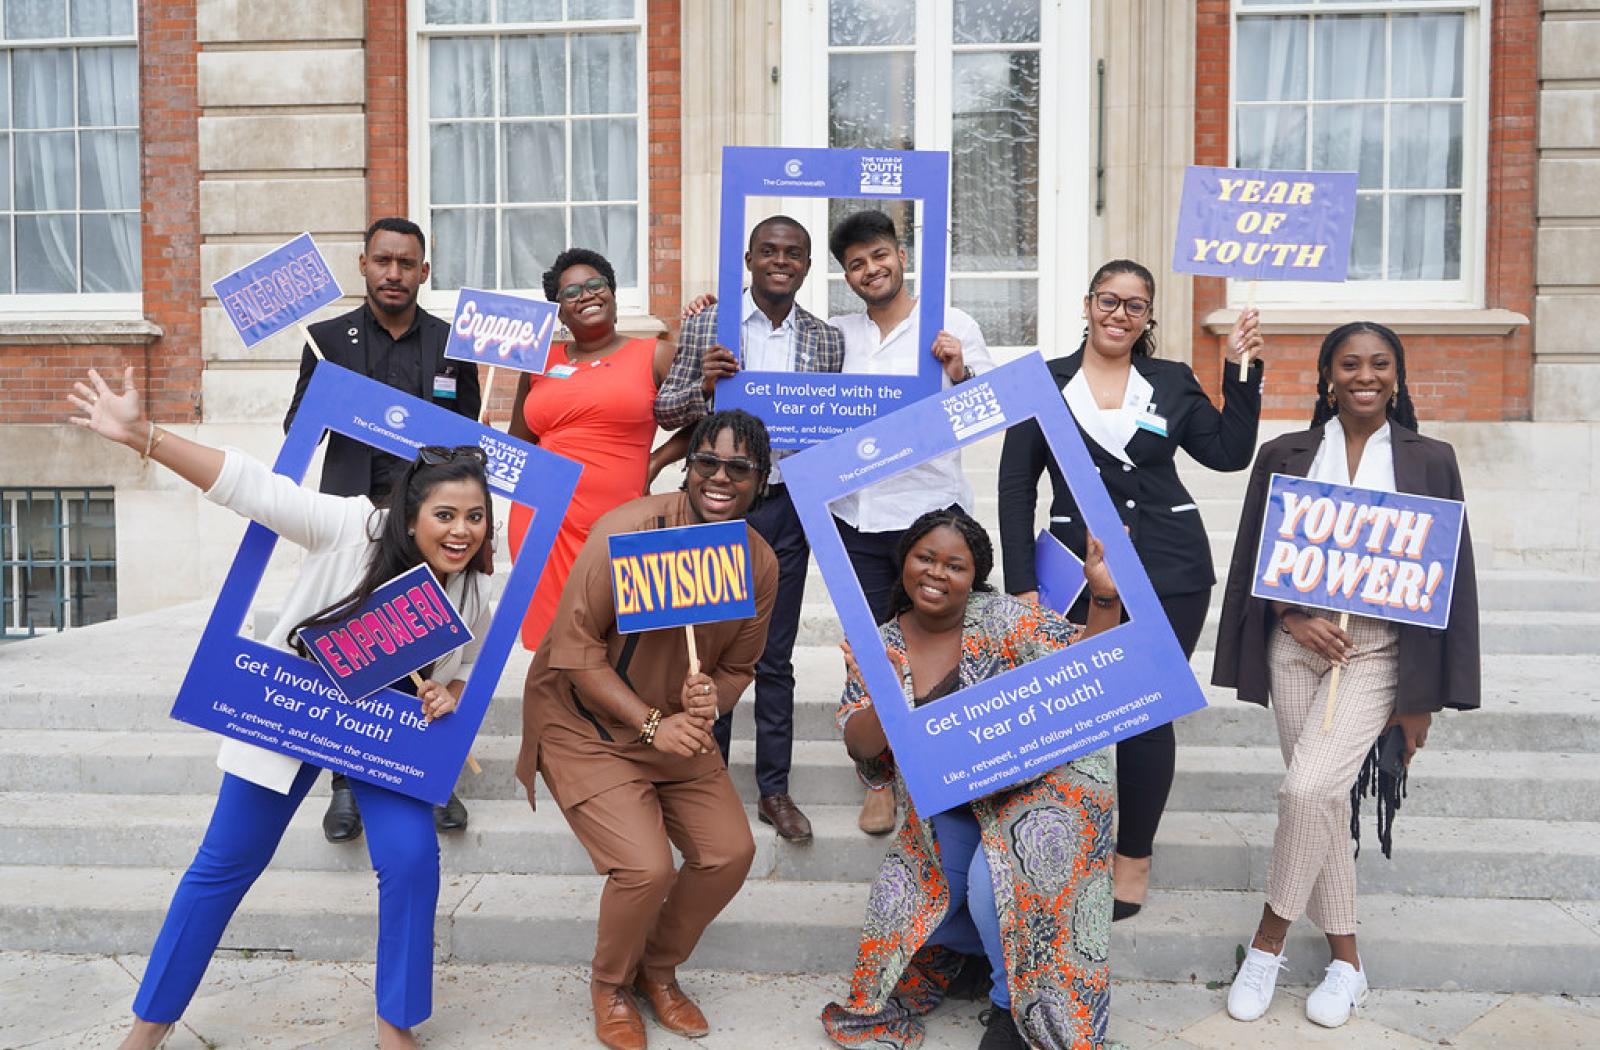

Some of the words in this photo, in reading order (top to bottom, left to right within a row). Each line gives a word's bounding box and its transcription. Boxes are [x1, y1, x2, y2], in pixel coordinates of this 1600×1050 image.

[763, 178, 776, 186] The
[776, 179, 826, 187] Commonwealth
[861, 163, 902, 172] YOUTH
[1217, 178, 1315, 205] YEAR
[1236, 211, 1288, 234] OF
[1193, 238, 1328, 268] YOUTH
[224, 250, 330, 331] ENERGISE!
[456, 300, 551, 360] Engage!
[745, 382, 771, 396] Get
[776, 383, 837, 398] Involved
[841, 385, 873, 399] with
[878, 386, 902, 399] the
[773, 401, 806, 415] Year
[810, 402, 825, 415] of
[830, 403, 877, 416] Youth!
[944, 388, 995, 416] YOUTH
[353, 416, 368, 428] The
[818, 426, 843, 434] follow
[480, 440, 526, 469] YOUTH
[839, 472, 854, 482] The
[854, 448, 913, 476] Commonwealth
[1278, 492, 1434, 559] YOUTH
[611, 544, 747, 615] ENVISION!
[1262, 540, 1444, 613] POWER!
[315, 582, 458, 677] EMPOWER!
[235, 653, 270, 677] Get
[356, 700, 394, 720] with
[400, 711, 429, 731] the
[264, 686, 306, 713] Year
[308, 704, 330, 721] of
[335, 710, 393, 742] Youth!
[926, 712, 962, 735] Get
[964, 677, 1042, 721] Involved
[1045, 660, 1089, 688] with
[1091, 647, 1125, 670] the
[968, 717, 1012, 744] Year
[1018, 704, 1037, 726] of
[1041, 679, 1105, 716] Youth!
[212, 701, 238, 718] Like,
[241, 712, 284, 734] retweet,
[288, 728, 308, 740] and
[310, 733, 342, 750] follow
[344, 745, 362, 757] the
[362, 752, 424, 778] conversation
[226, 722, 278, 744] #YearofYouth
[282, 741, 364, 772] #CommonwealthYouth
[944, 770, 970, 785] Like,
[972, 750, 1018, 774] retweet,
[1020, 739, 1040, 754] and
[1040, 728, 1073, 746] follow
[1075, 719, 1093, 732] the
[1095, 692, 1162, 724] conversation
[968, 765, 1020, 790] #YearofYouth
[1024, 730, 1110, 768] #CommonwealthYouth
